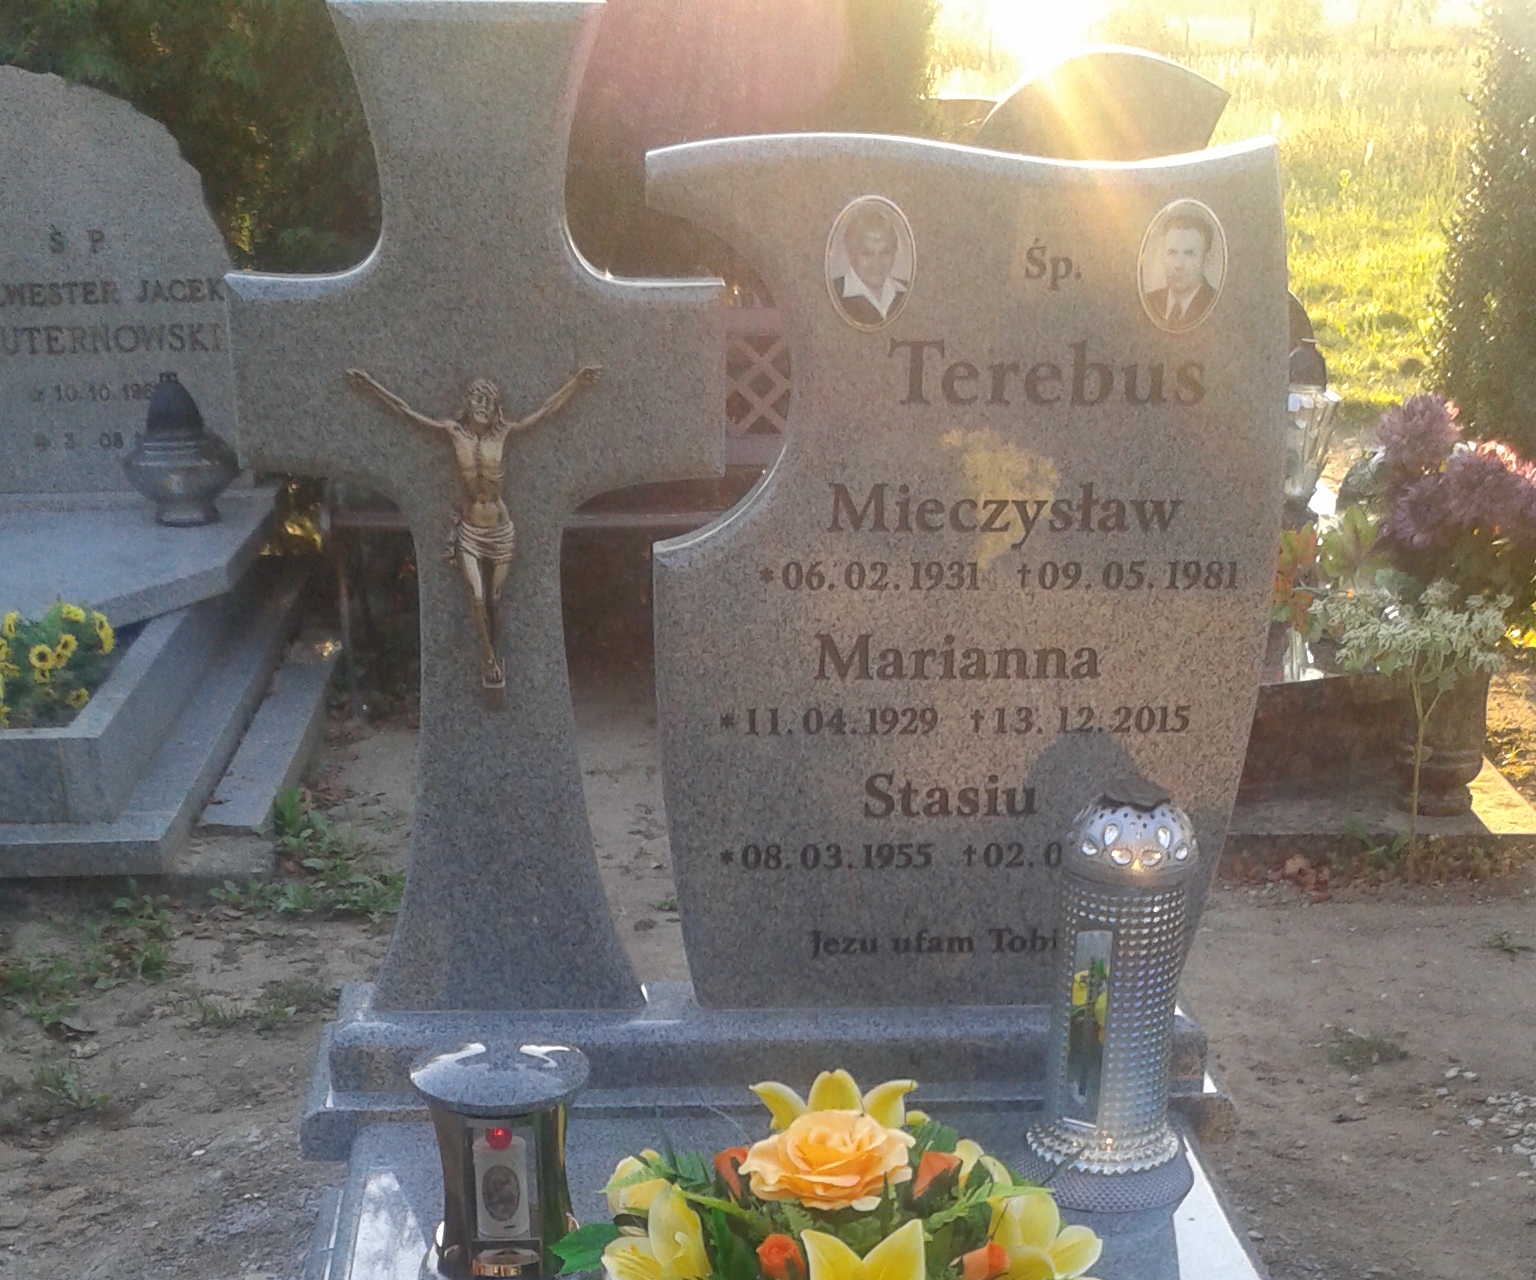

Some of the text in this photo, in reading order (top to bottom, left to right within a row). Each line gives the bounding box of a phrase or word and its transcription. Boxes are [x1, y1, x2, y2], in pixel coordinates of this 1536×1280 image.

[1025, 237, 1082, 290] Śp.
[0, 277, 225, 308] WESTER JACEK
[889, 338, 1206, 408] Terebus
[826, 481, 1184, 551] Mieczysław
[813, 633, 1102, 682] Marianna
[862, 771, 1038, 819] Stasiu
[809, 927, 1059, 960] Jezu ufam Tobi
